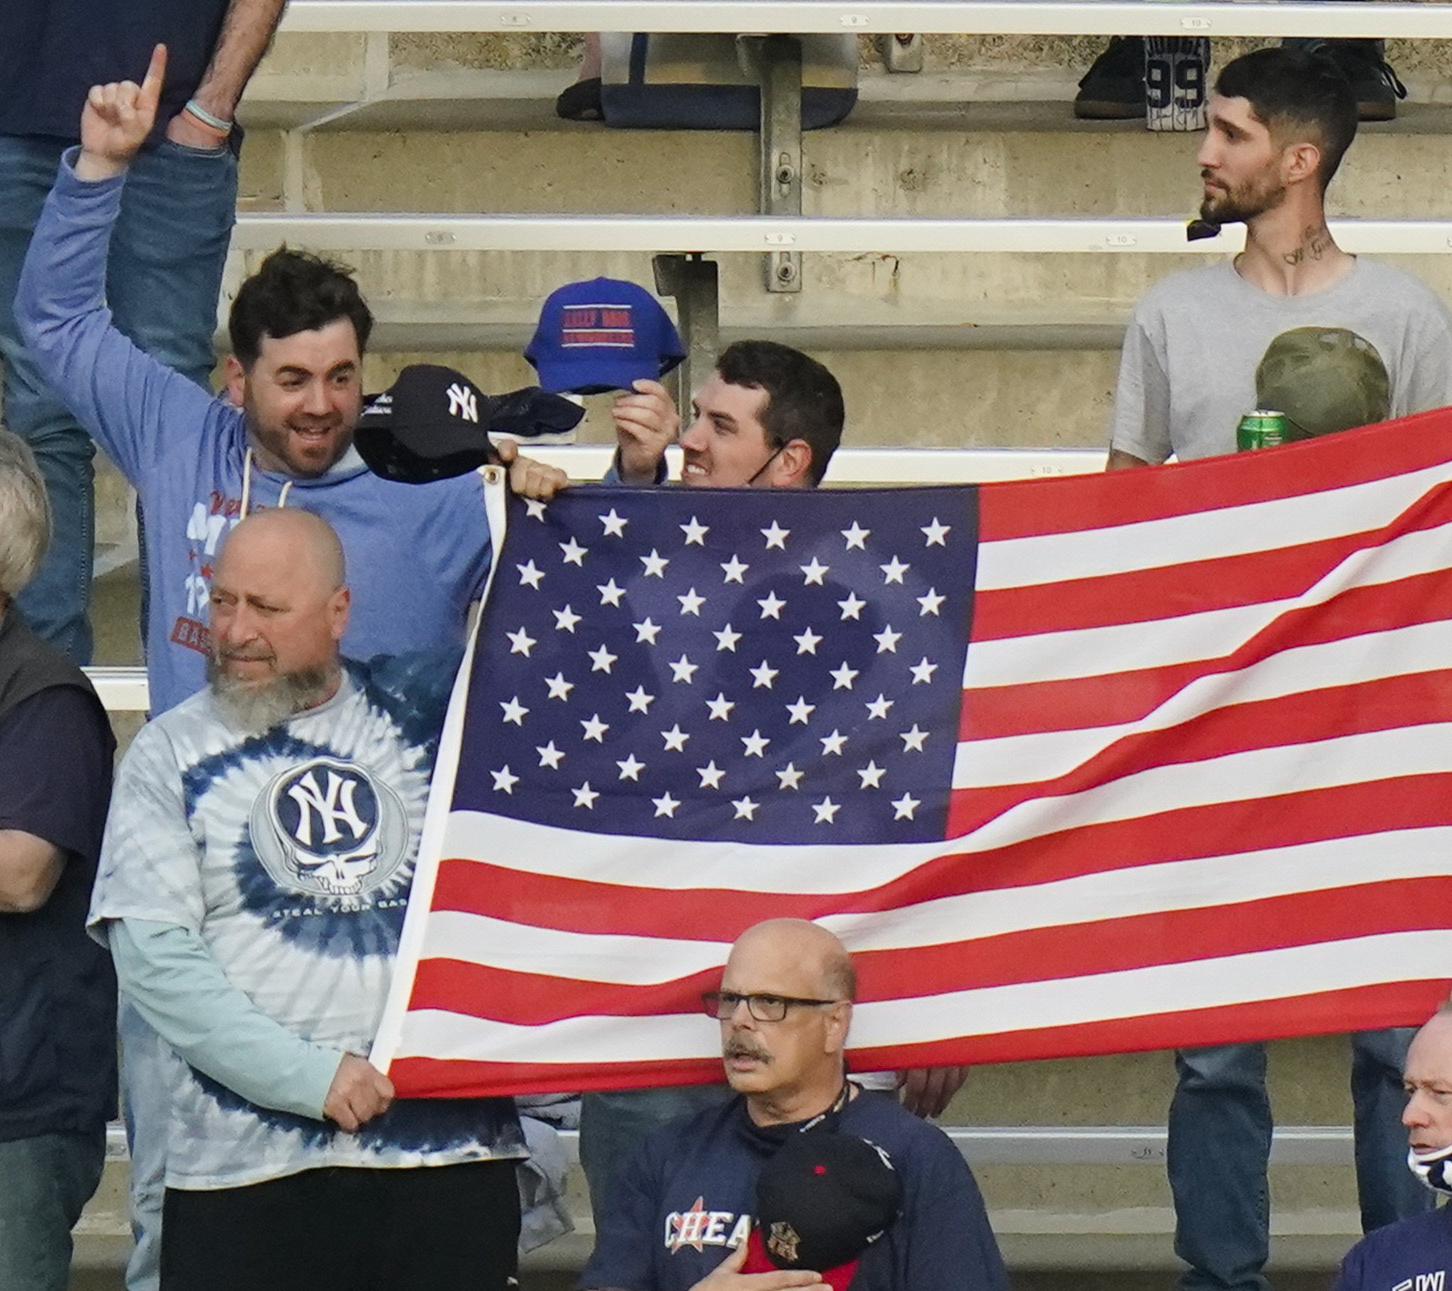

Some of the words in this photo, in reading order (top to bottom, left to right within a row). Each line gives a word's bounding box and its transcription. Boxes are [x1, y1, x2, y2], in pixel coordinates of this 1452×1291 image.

[1145, 58, 1205, 108] 99
[446, 382, 479, 424] NY
[288, 770, 368, 846] NY
[273, 906, 323, 919] STEAL
[330, 902, 370, 914] YOUR
